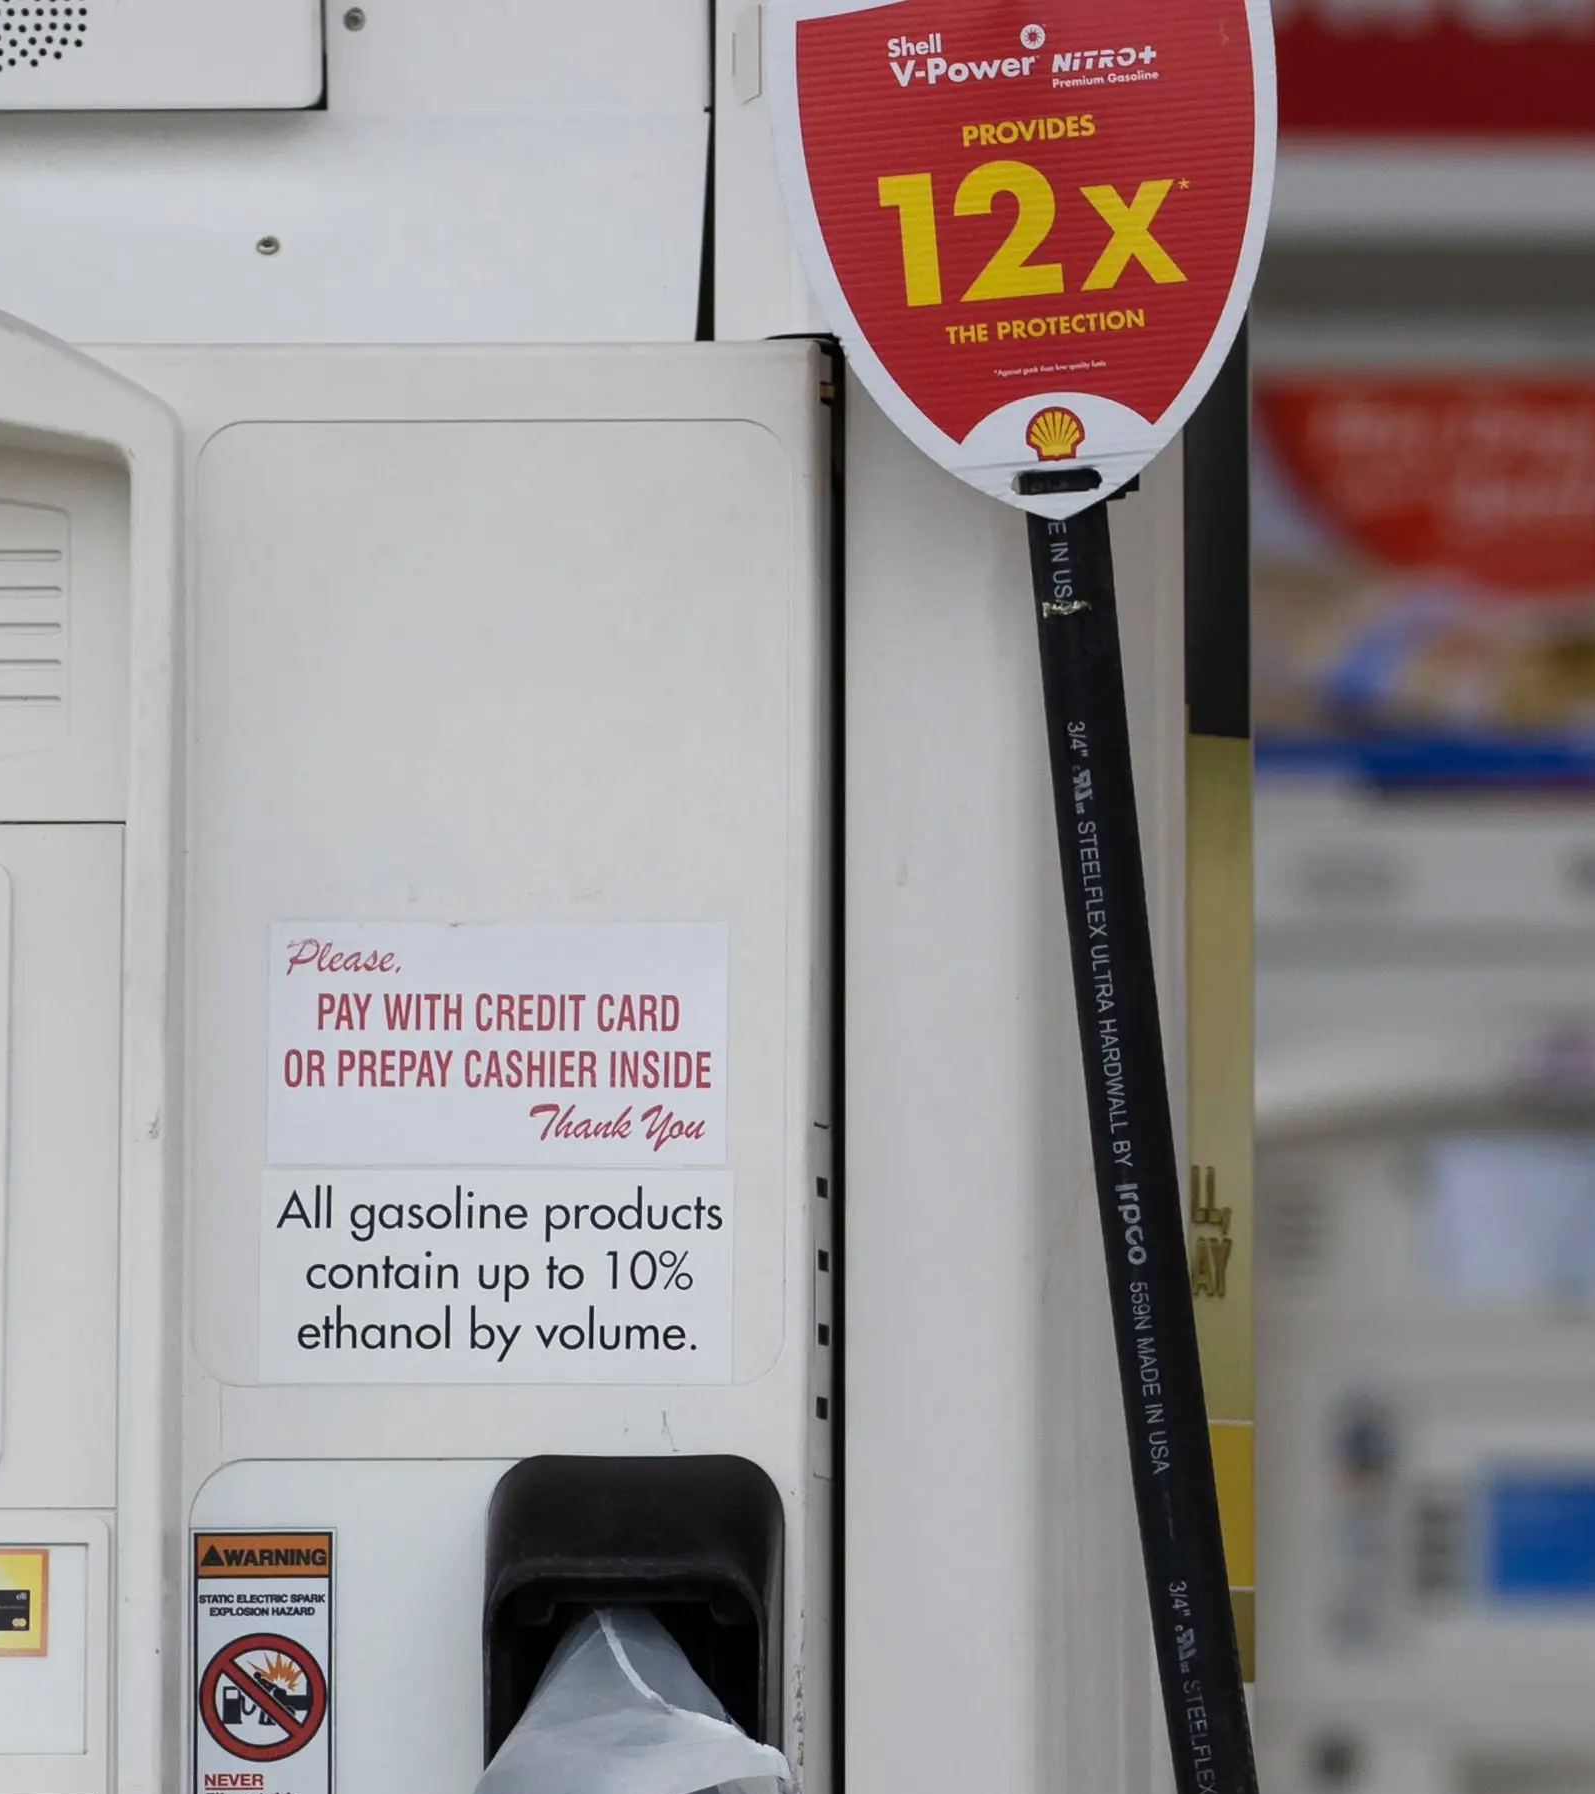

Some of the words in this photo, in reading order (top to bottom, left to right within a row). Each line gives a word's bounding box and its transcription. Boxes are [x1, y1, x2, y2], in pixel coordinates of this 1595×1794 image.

[887, 33, 942, 58] Shell
[889, 55, 1036, 88] V-Power
[1052, 75, 1105, 89] Premium
[1107, 69, 1159, 84] Gasoline
[962, 114, 1096, 147] PROVIDES
[945, 323, 988, 344] THE
[997, 309, 1145, 340] PROTECTION
[1077, 820, 1109, 937] STEELFLEX
[1090, 943, 1118, 1014] ULTRA
[317, 993, 372, 1031] PAY
[384, 994, 463, 1030] WITH
[475, 994, 586, 1032] CREDIT
[596, 994, 680, 1032] CARD
[284, 1049, 325, 1088] OR
[337, 1050, 453, 1088] PREPAY
[464, 1050, 597, 1088] CASHIER
[610, 1051, 712, 1088] INSIDE
[1097, 1018, 1130, 1134] HARDWALL
[529, 1103, 632, 1141] Thank
[640, 1104, 706, 1151] You
[1112, 1140, 1133, 1167] BY
[277, 1185, 332, 1229] All
[350, 1185, 528, 1242] gasoline
[545, 1186, 723, 1242] products
[306, 1251, 459, 1290] contain
[478, 1263, 529, 1302] up
[546, 1256, 584, 1290] to
[605, 1250, 694, 1291] 10%
[1129, 1281, 1152, 1331] 559N
[298, 1305, 451, 1350] ethanol
[470, 1305, 521, 1363] by
[535, 1305, 697, 1351] volume.
[1135, 1337, 1161, 1398] MADE
[1144, 1401, 1164, 1426] IN
[1148, 1429, 1172, 1476] USA
[224, 1549, 326, 1566] WARNING
[199, 1595, 234, 1604] STATIC
[237, 1594, 288, 1604] ELECTRIC
[291, 1594, 325, 1603] SPARK
[209, 1607, 269, 1616] EXPLOSION
[272, 1607, 315, 1616] HAZARD
[204, 1774, 264, 1786] NEVER
